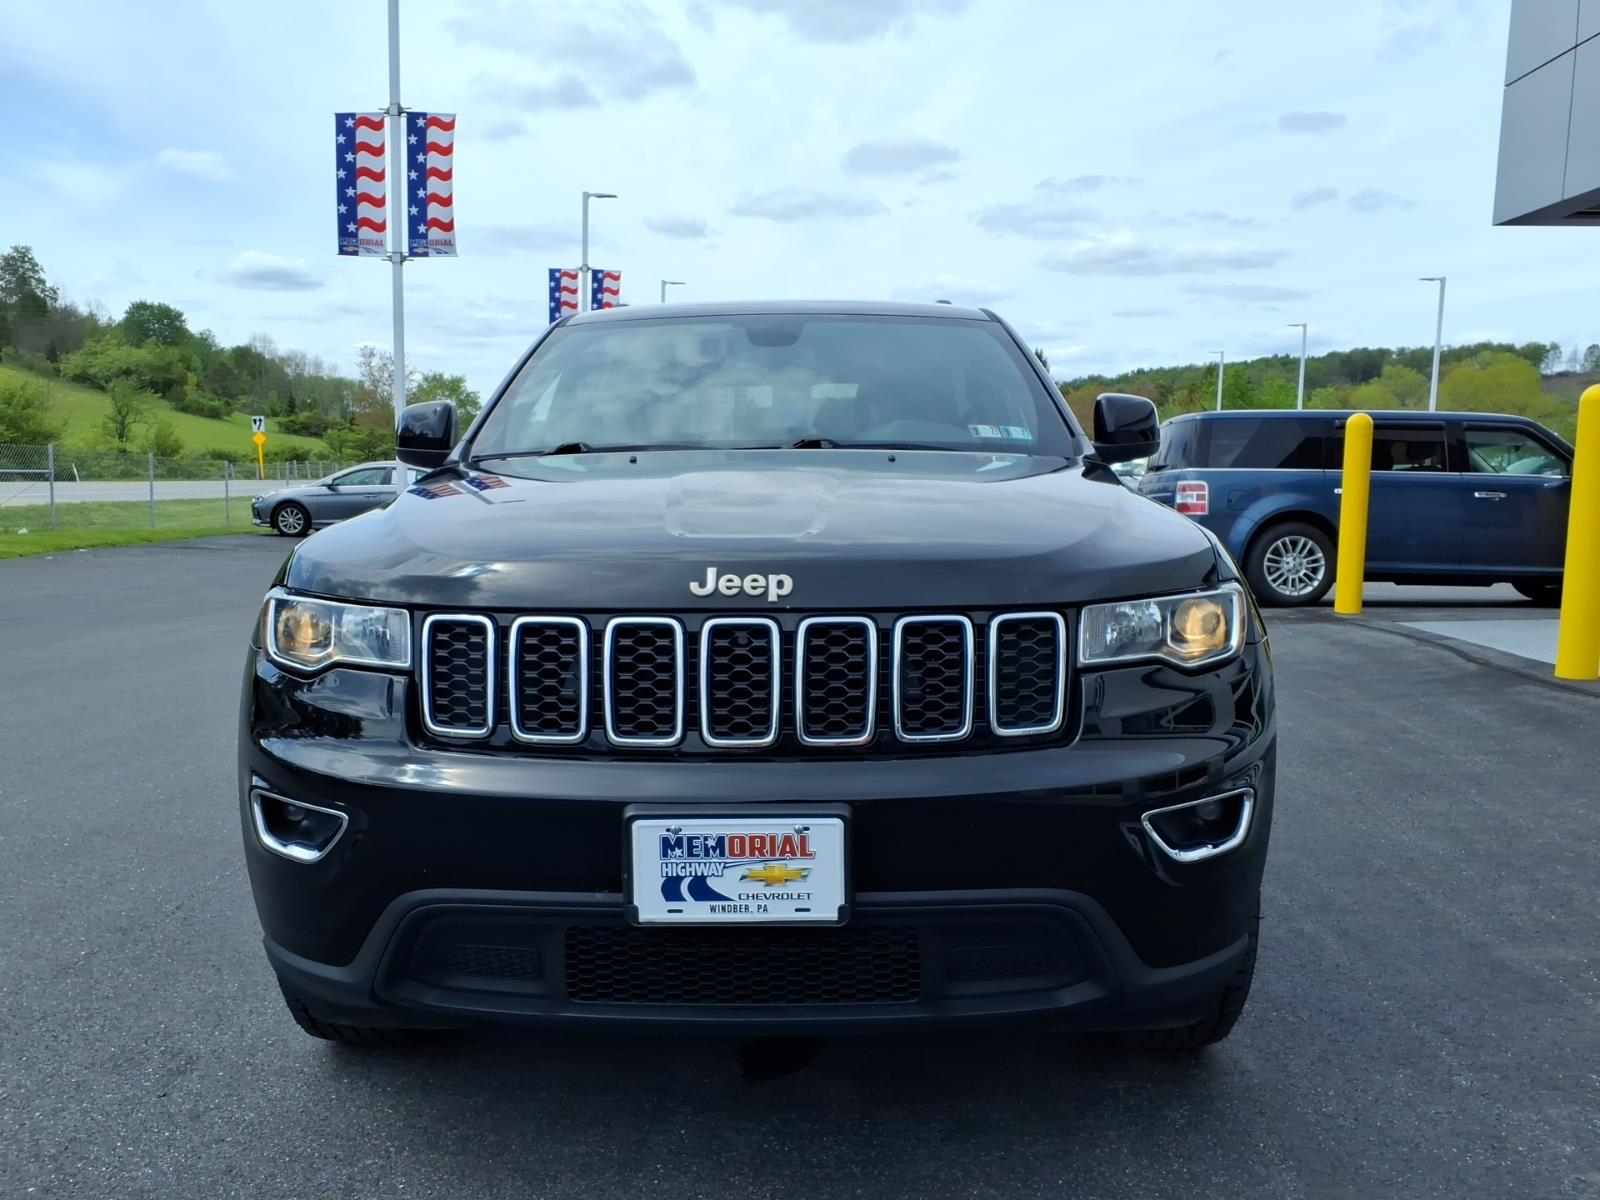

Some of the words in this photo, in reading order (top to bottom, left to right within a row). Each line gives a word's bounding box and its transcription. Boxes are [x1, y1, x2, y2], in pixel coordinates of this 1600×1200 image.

[690, 567, 793, 602] Jeep
[660, 833, 816, 859] MEMORIAL
[661, 861, 725, 877] HIGHWAY
[738, 892, 813, 901] CHEVROLET
[757, 904, 769, 913] PA
